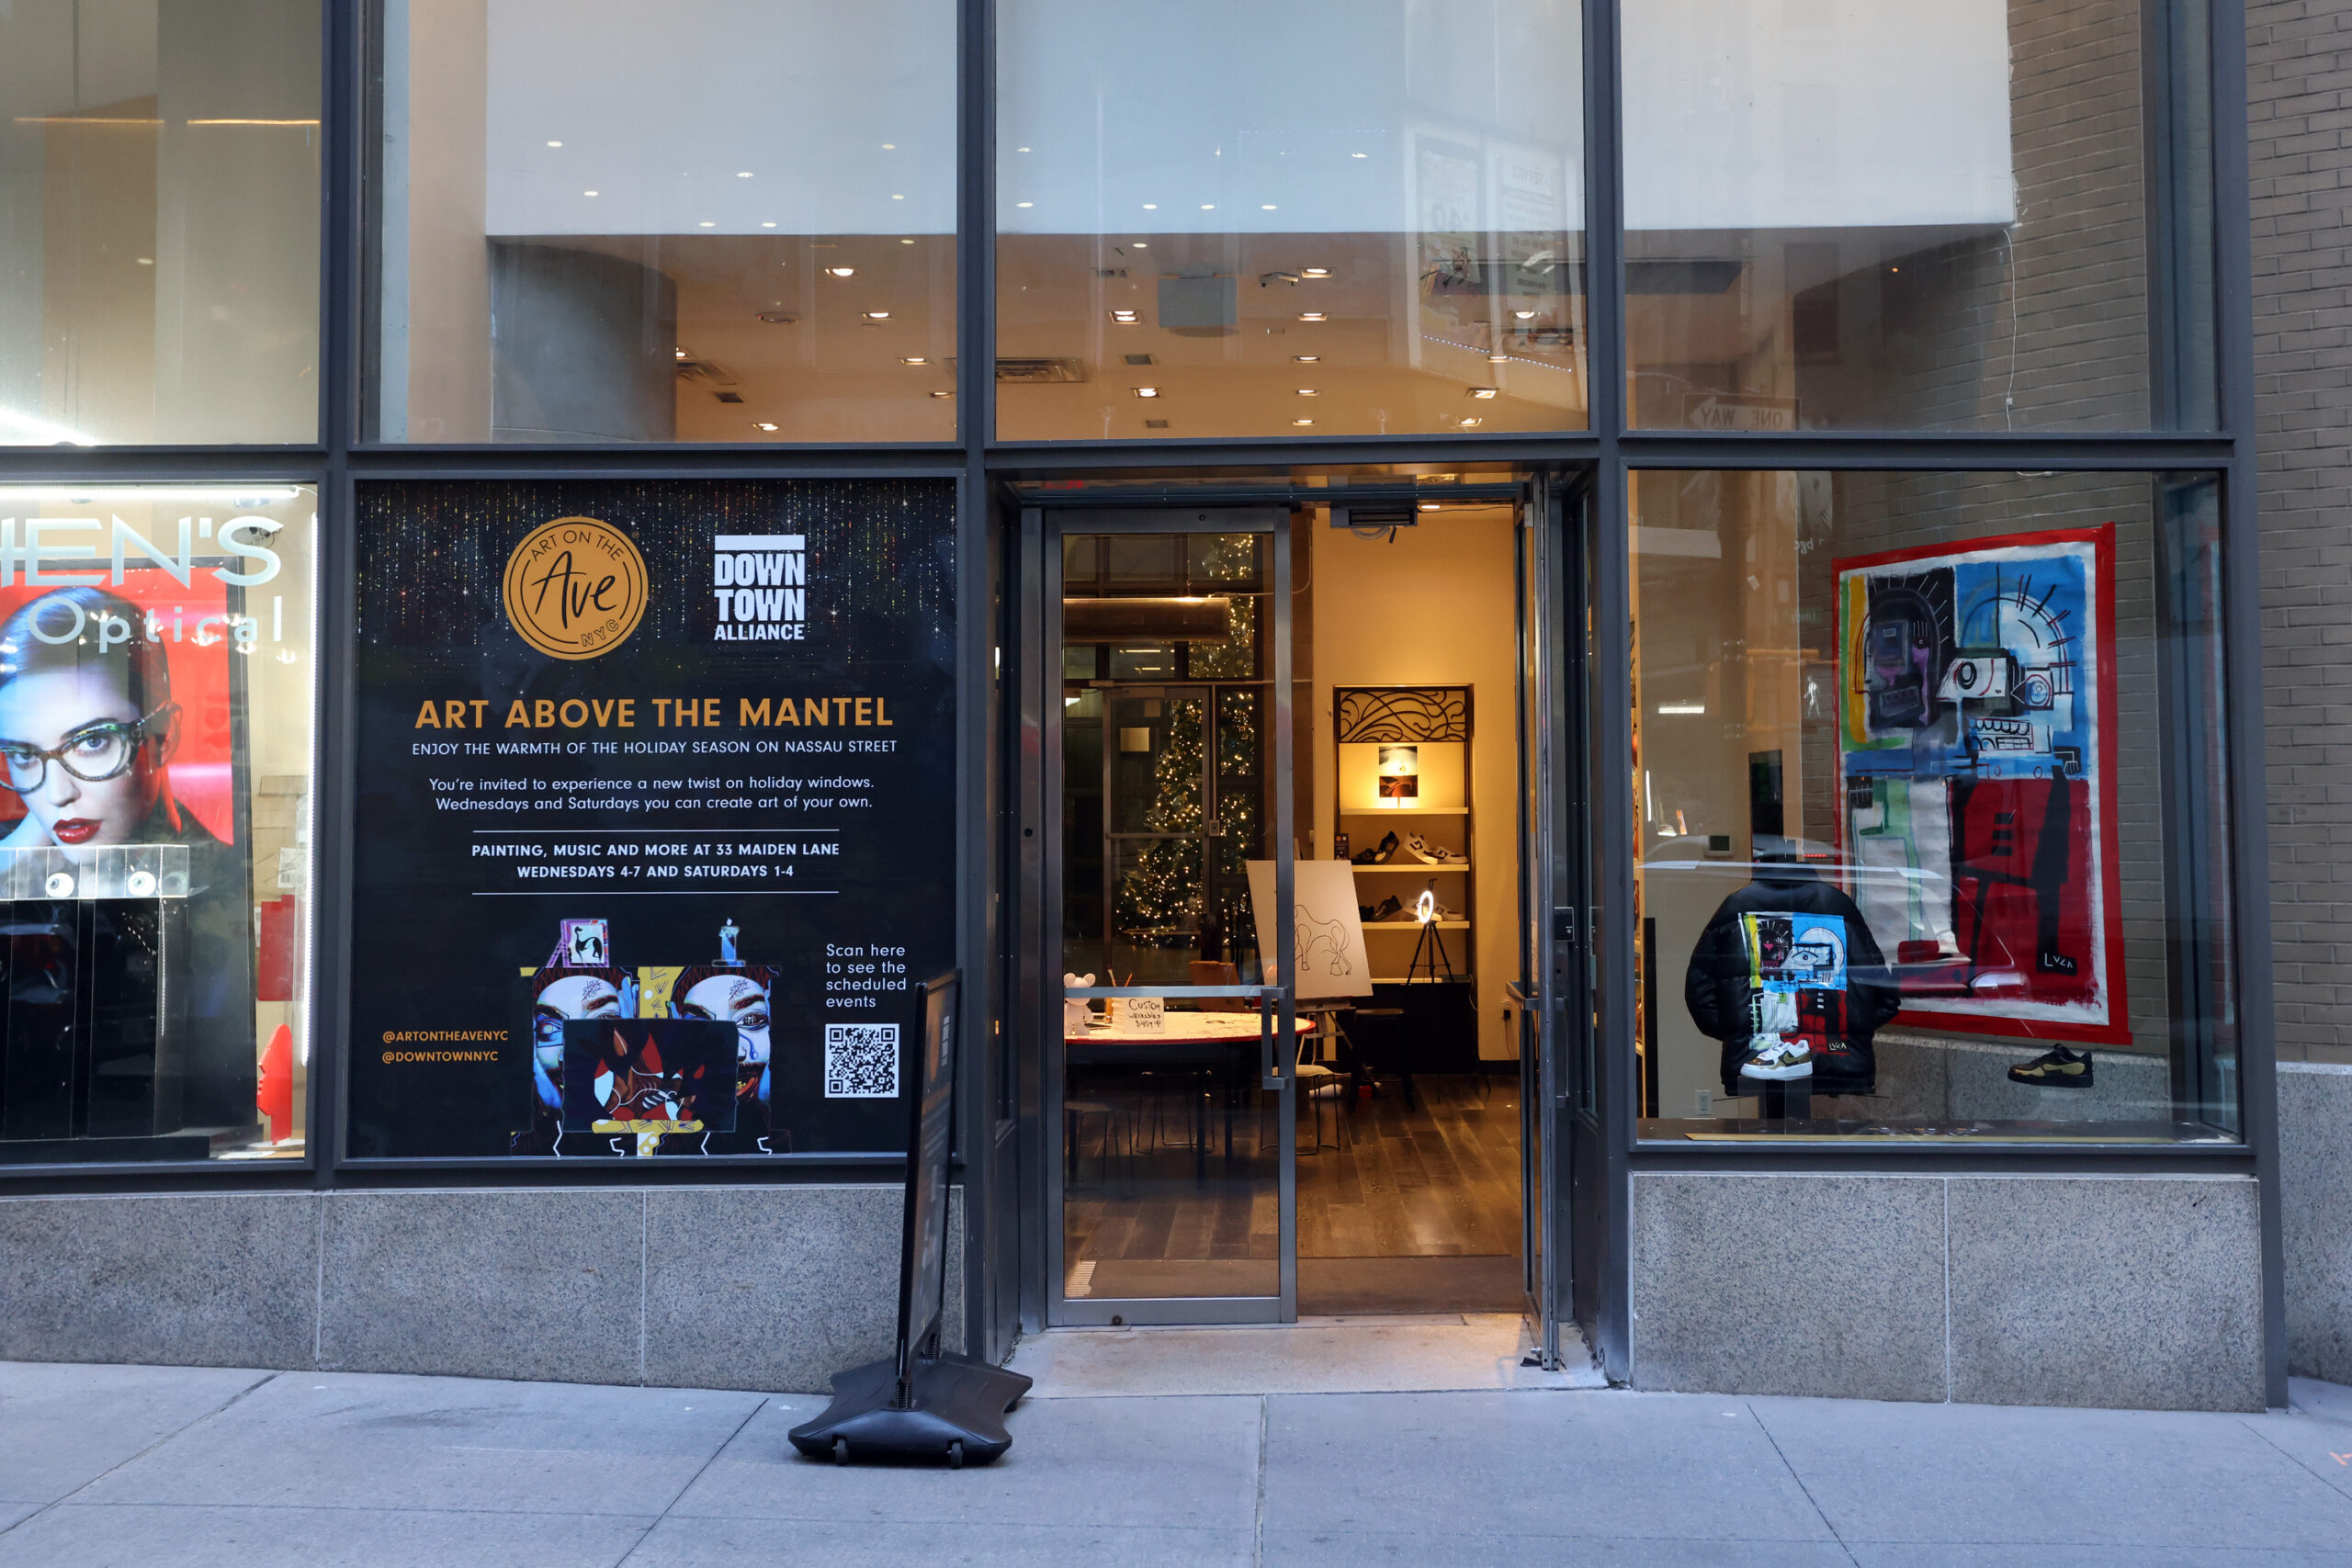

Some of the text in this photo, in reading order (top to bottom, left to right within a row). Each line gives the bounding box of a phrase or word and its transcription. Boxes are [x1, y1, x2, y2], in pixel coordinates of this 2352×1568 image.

[530, 529, 626, 562] ART ON THE
[714, 553, 805, 586] DOWN
[531, 550, 618, 629] Ave
[714, 589, 805, 622] TOWN
[28, 595, 282, 654] Optical
[580, 618, 619, 648] NYC
[714, 624, 805, 641] ALLIANCE
[415, 697, 893, 728] ART ABOVE THE MANTEL
[413, 740, 897, 755] ENJOY THE WARMTH OF THE HOLIDAY SEASON ON NASSAU STREET
[429, 776, 874, 794] You're invited to experience a new twist on holiday windows.
[436, 795, 872, 813] Wednesdays and Saturdays you can create art of your own.
[472, 843, 840, 859] PAINTING, MUSIC AND MORE AT 33 MAIDEN LANE
[517, 865, 794, 878] WEDNESDAYS 4-7 AND SATURDAYS 1-4
[826, 943, 905, 957] Scan here
[826, 961, 906, 974] to see the
[826, 977, 906, 991] scheduled
[826, 996, 876, 1008] events
[383, 1031, 508, 1044] @ARTONTHEAVENYC
[382, 1052, 499, 1065] @DOWNTOWNNYC
